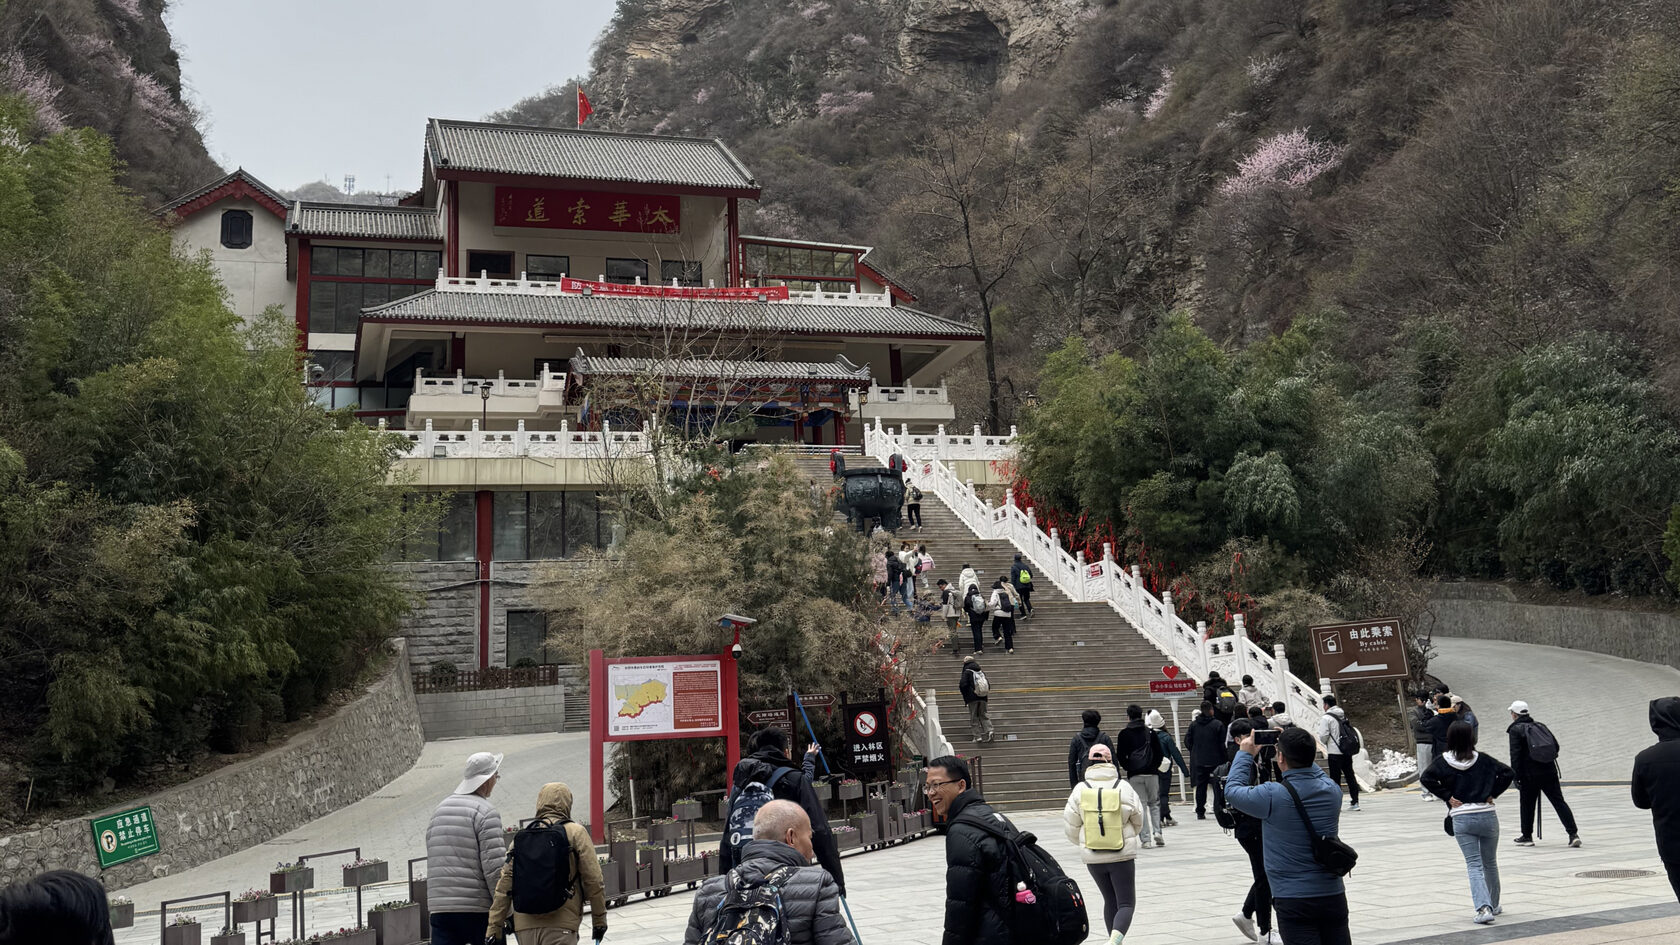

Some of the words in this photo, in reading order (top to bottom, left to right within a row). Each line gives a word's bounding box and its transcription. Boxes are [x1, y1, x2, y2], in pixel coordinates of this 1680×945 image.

[1349, 625, 1393, 640] 由此乘索
[853, 742, 884, 752] 进入林区
[854, 753, 885, 764] 严禁烟火
[116, 812, 148, 829] 应急通道
[118, 824, 151, 840] 禁止停车
